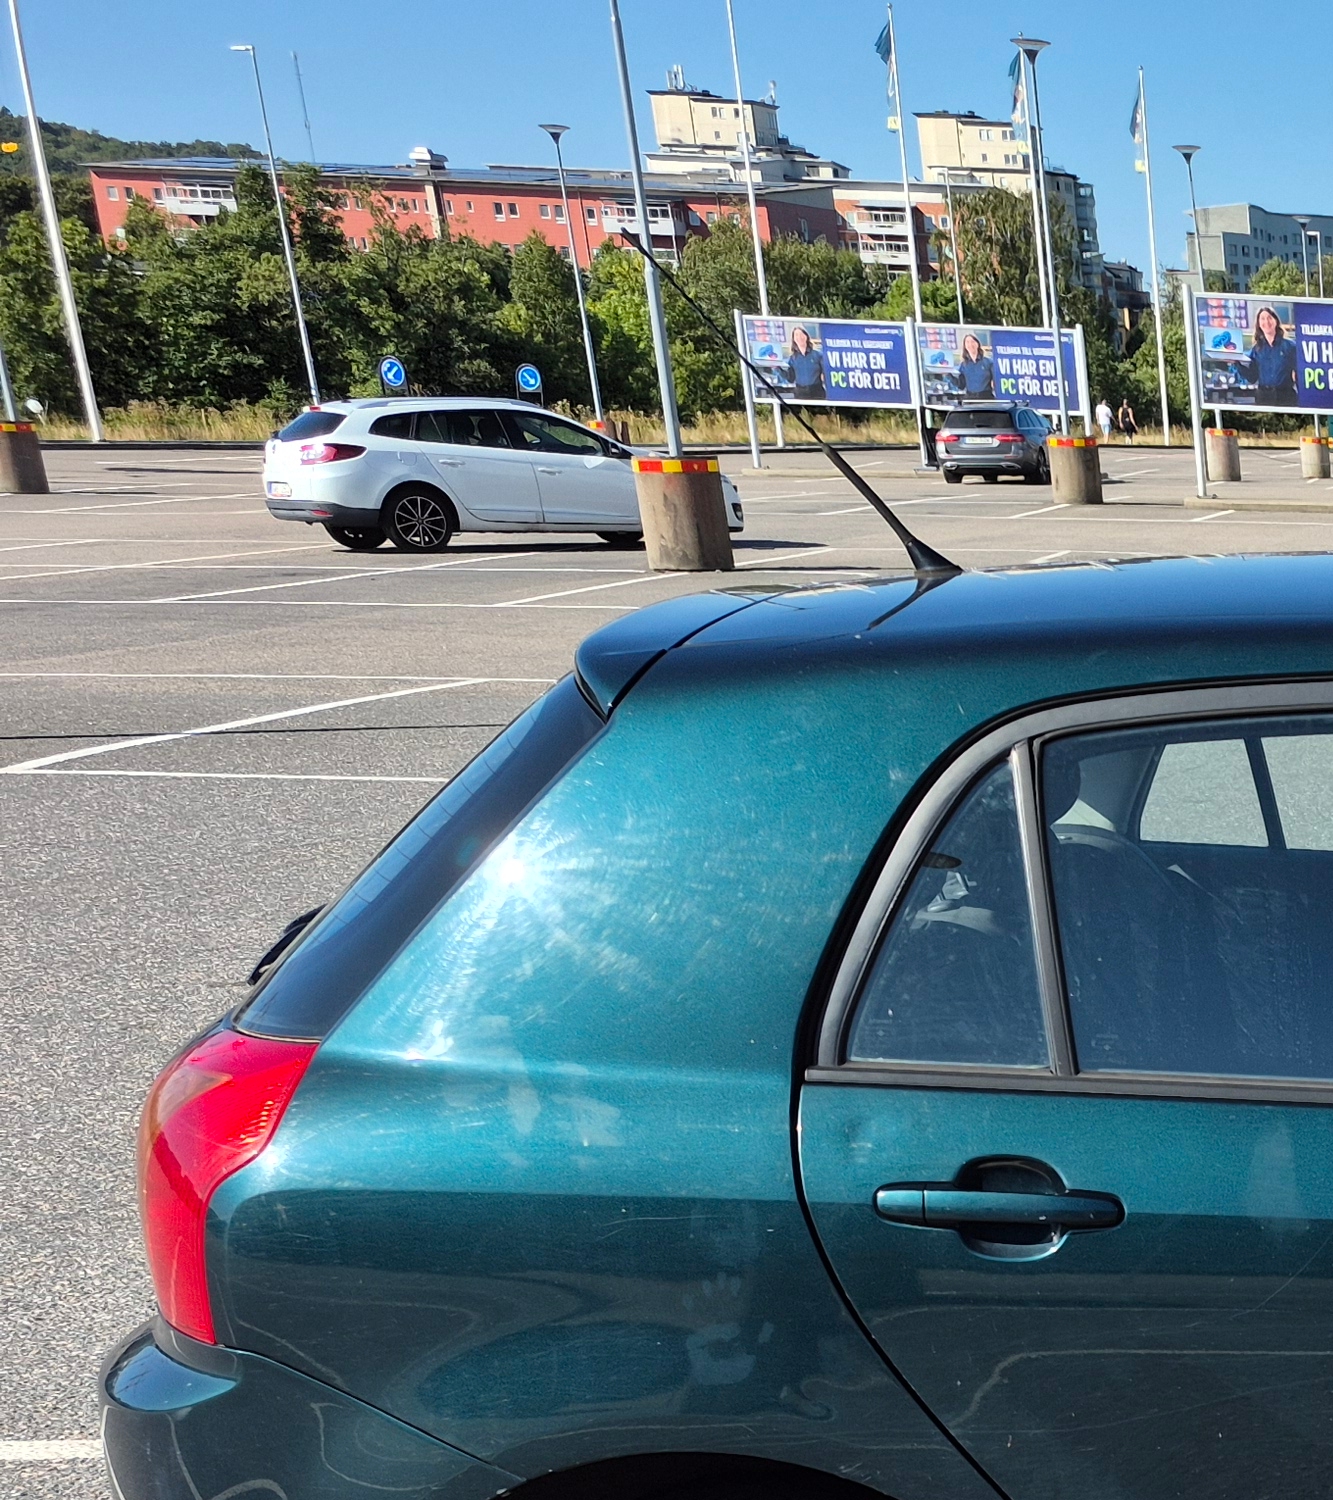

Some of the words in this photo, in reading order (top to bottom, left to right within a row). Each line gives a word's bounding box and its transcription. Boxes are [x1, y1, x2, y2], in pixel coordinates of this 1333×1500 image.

[827, 351, 840, 368] VI
[842, 352, 868, 369] HAR
[869, 353, 886, 370] EN
[1301, 341, 1318, 363] VI
[998, 358, 1011, 375] VI
[1012, 358, 1037, 376] HAR
[1039, 360, 1055, 377] EN
[830, 371, 847, 388] PC
[848, 369, 872, 389] FÖR
[873, 372, 901, 390] DET!
[1001, 378, 1017, 395] PC
[1018, 376, 1041, 396] FÖR
[1043, 379, 1069, 397] DE!
[1304, 367, 1325, 390] PC
